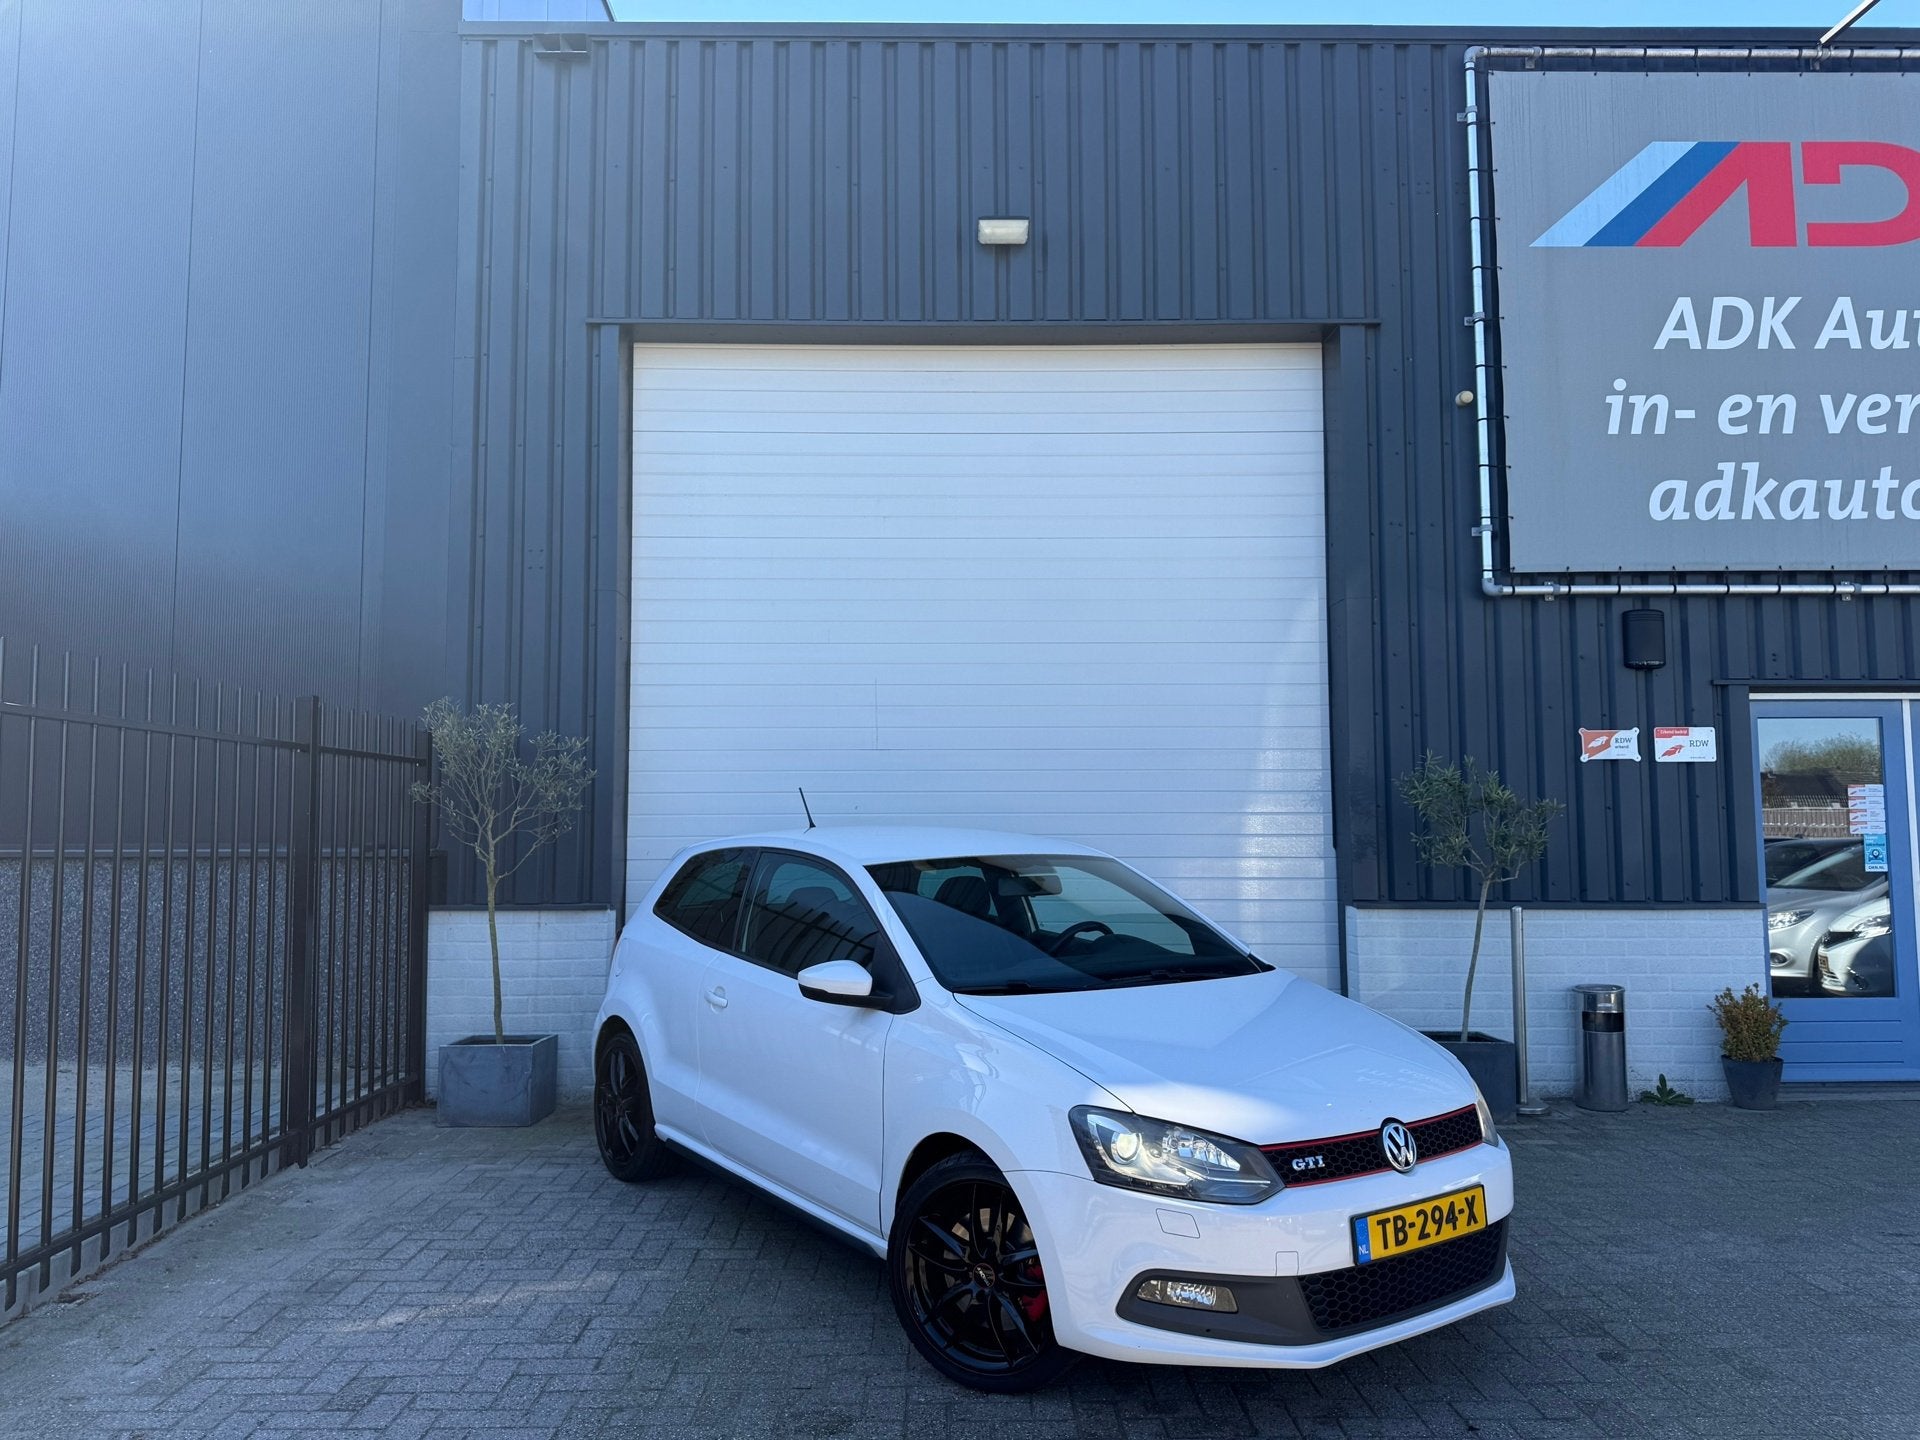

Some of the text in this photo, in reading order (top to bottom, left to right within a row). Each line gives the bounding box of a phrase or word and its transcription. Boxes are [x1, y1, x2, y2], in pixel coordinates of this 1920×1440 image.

[1652, 296, 1920, 350] ADK Au
[1604, 378, 1920, 435] in- en ver
[1689, 739, 1709, 748] RDW
[1292, 1155, 1326, 1171] GTI
[1376, 1194, 1479, 1250] TB-294-X
[1358, 1243, 1369, 1256] NL
